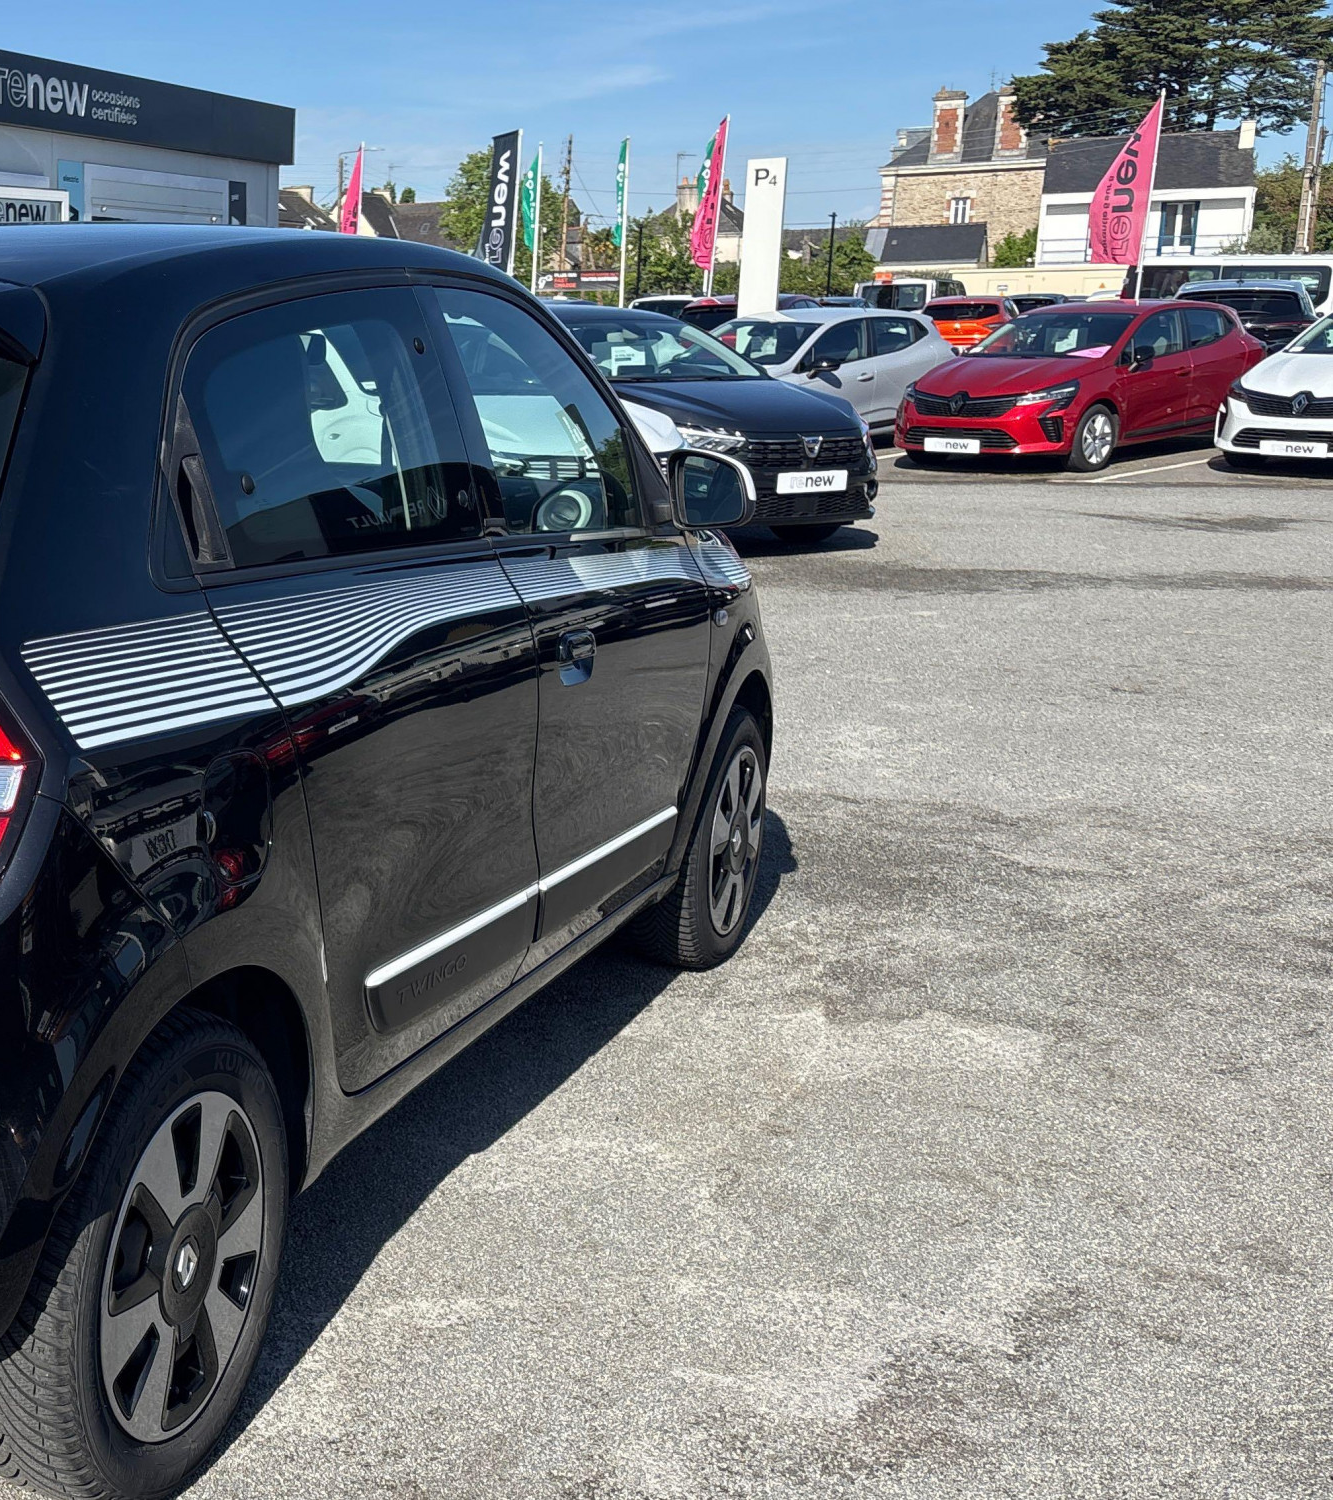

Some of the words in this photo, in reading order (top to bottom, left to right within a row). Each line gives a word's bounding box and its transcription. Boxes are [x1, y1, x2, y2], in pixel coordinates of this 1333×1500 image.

[92, 88, 141, 109] occasions
[91, 105, 138, 126] certifiées
[396, 953, 468, 1006] TWINGO
